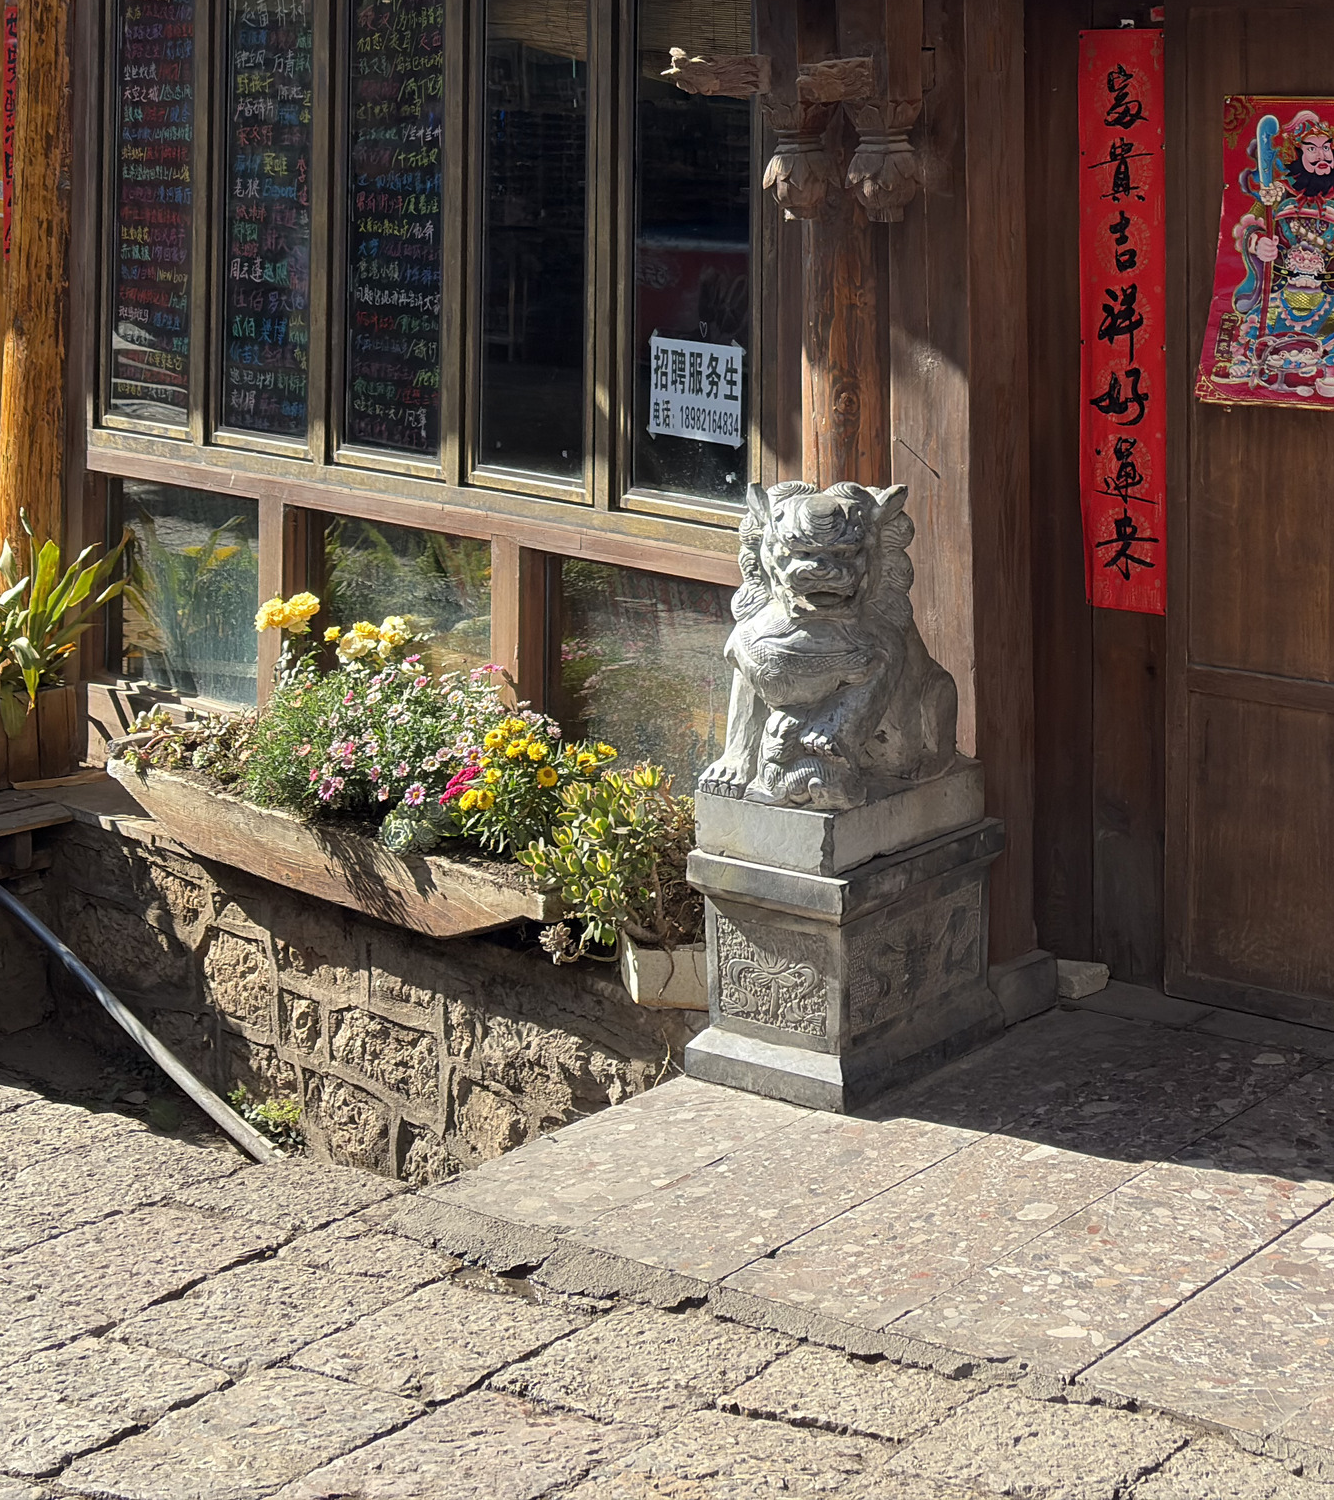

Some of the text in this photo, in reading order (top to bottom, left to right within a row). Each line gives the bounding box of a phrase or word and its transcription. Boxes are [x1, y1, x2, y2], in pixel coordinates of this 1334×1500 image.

[654, 345, 739, 402] 招聘服务生
